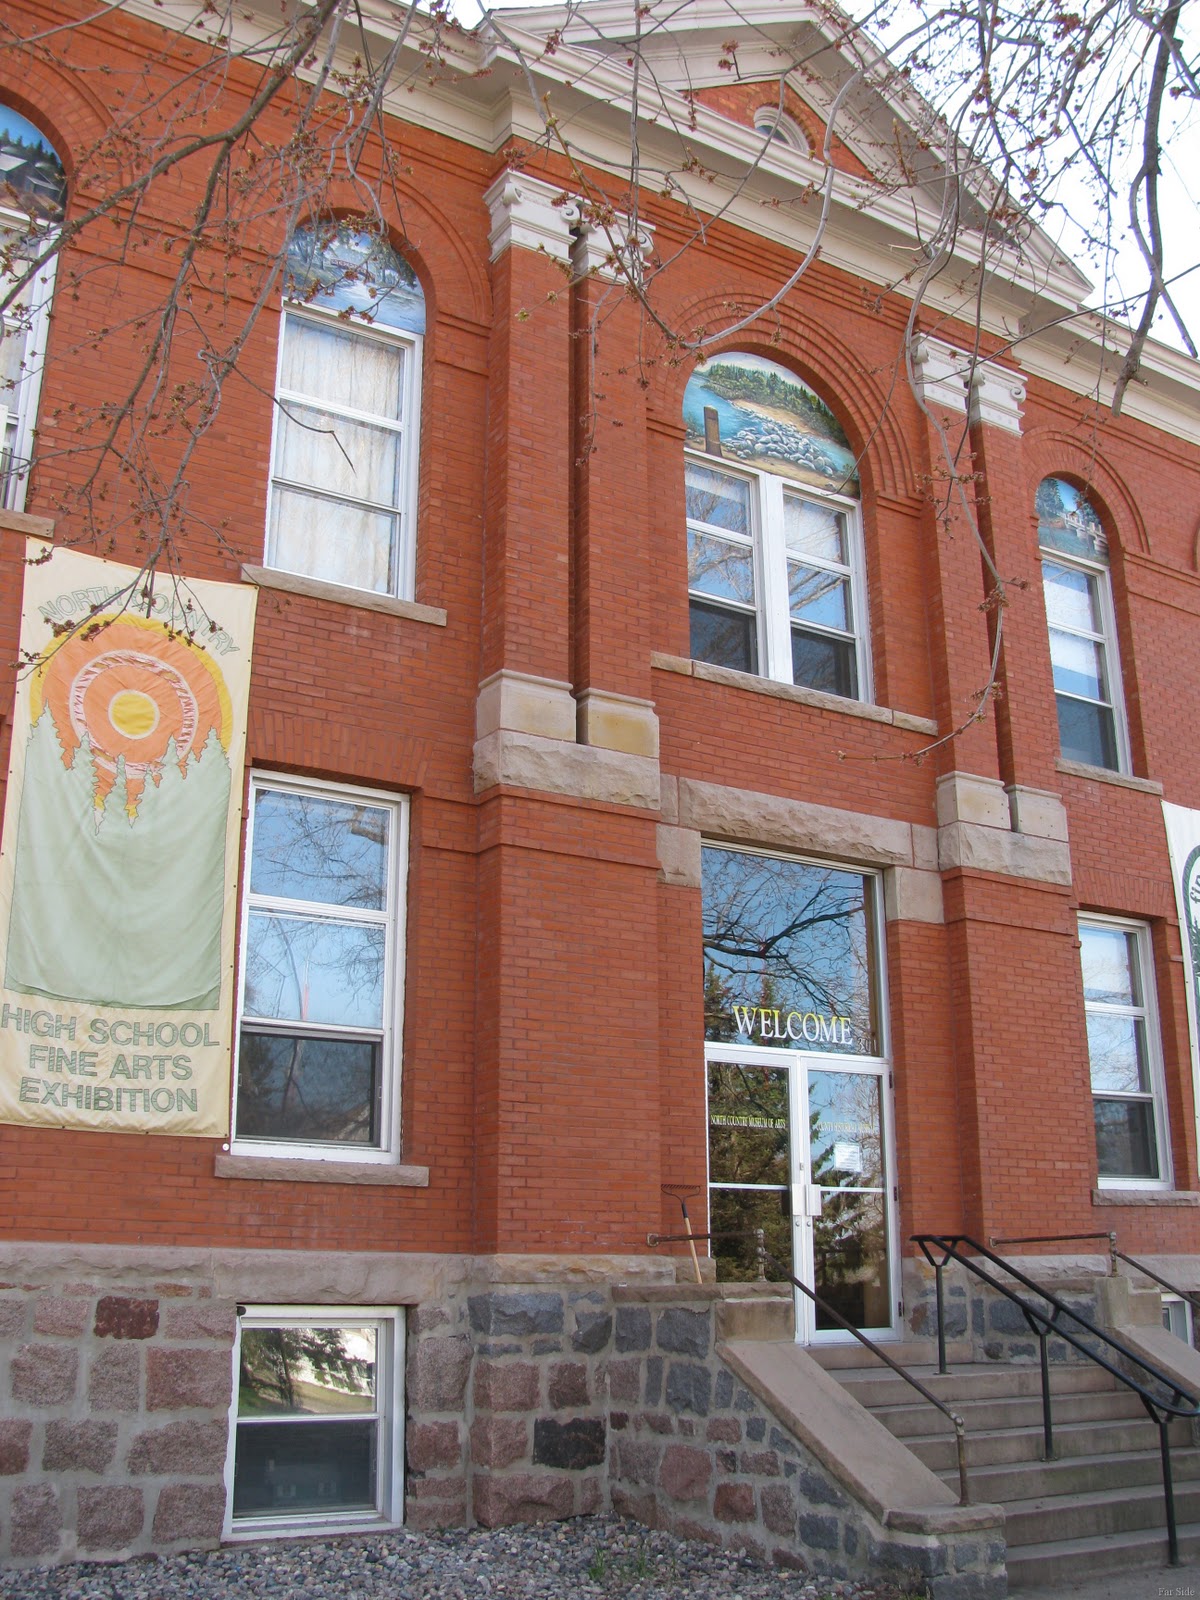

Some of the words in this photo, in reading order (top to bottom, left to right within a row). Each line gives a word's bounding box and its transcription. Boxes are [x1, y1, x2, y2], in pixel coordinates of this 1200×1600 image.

[38, 585, 125, 622] NORTH
[132, 588, 240, 656] COUNTRY
[1, 1003, 76, 1041] HIGH
[88, 1018, 220, 1047] SCHOOL
[732, 1005, 853, 1045] WELCOME
[29, 1044, 98, 1077] FINE
[110, 1054, 193, 1081] ARTS
[19, 1076, 198, 1113] EXHIBITION
[711, 1114, 727, 1126] NORTH
[748, 1116, 768, 1128] MUSEUM
[768, 1117, 774, 1129] OF
[774, 1118, 786, 1129] ARTS
